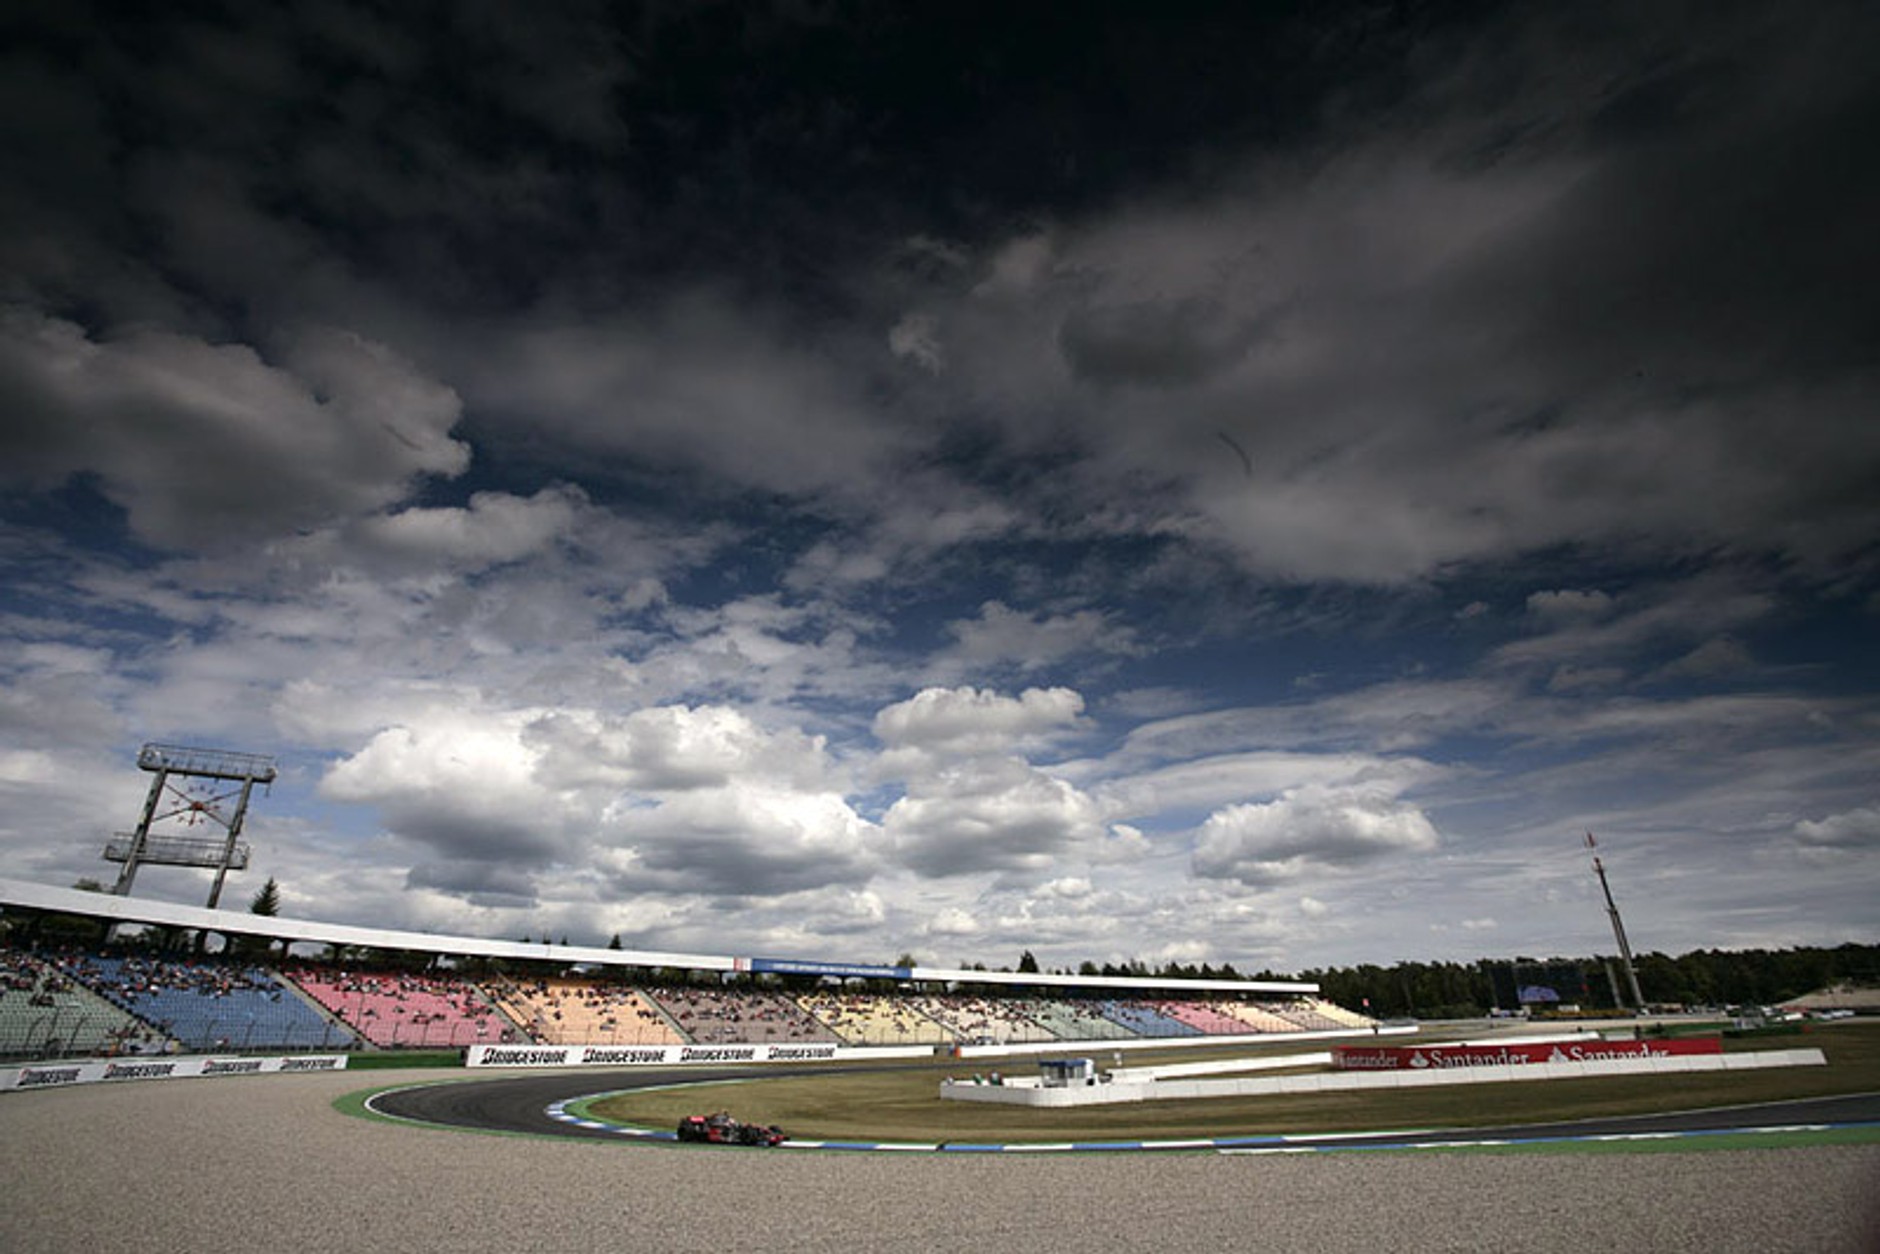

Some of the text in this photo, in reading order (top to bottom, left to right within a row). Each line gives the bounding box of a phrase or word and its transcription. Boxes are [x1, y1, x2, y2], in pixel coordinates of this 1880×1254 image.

[480, 1046, 568, 1065] BRIDGESTONE
[582, 1047, 667, 1063] BRIDGESTONE
[680, 1047, 756, 1062] BRIDGESTONE
[768, 1045, 835, 1060] BRIDGESTONE
[1430, 1048, 1530, 1068] Santander
